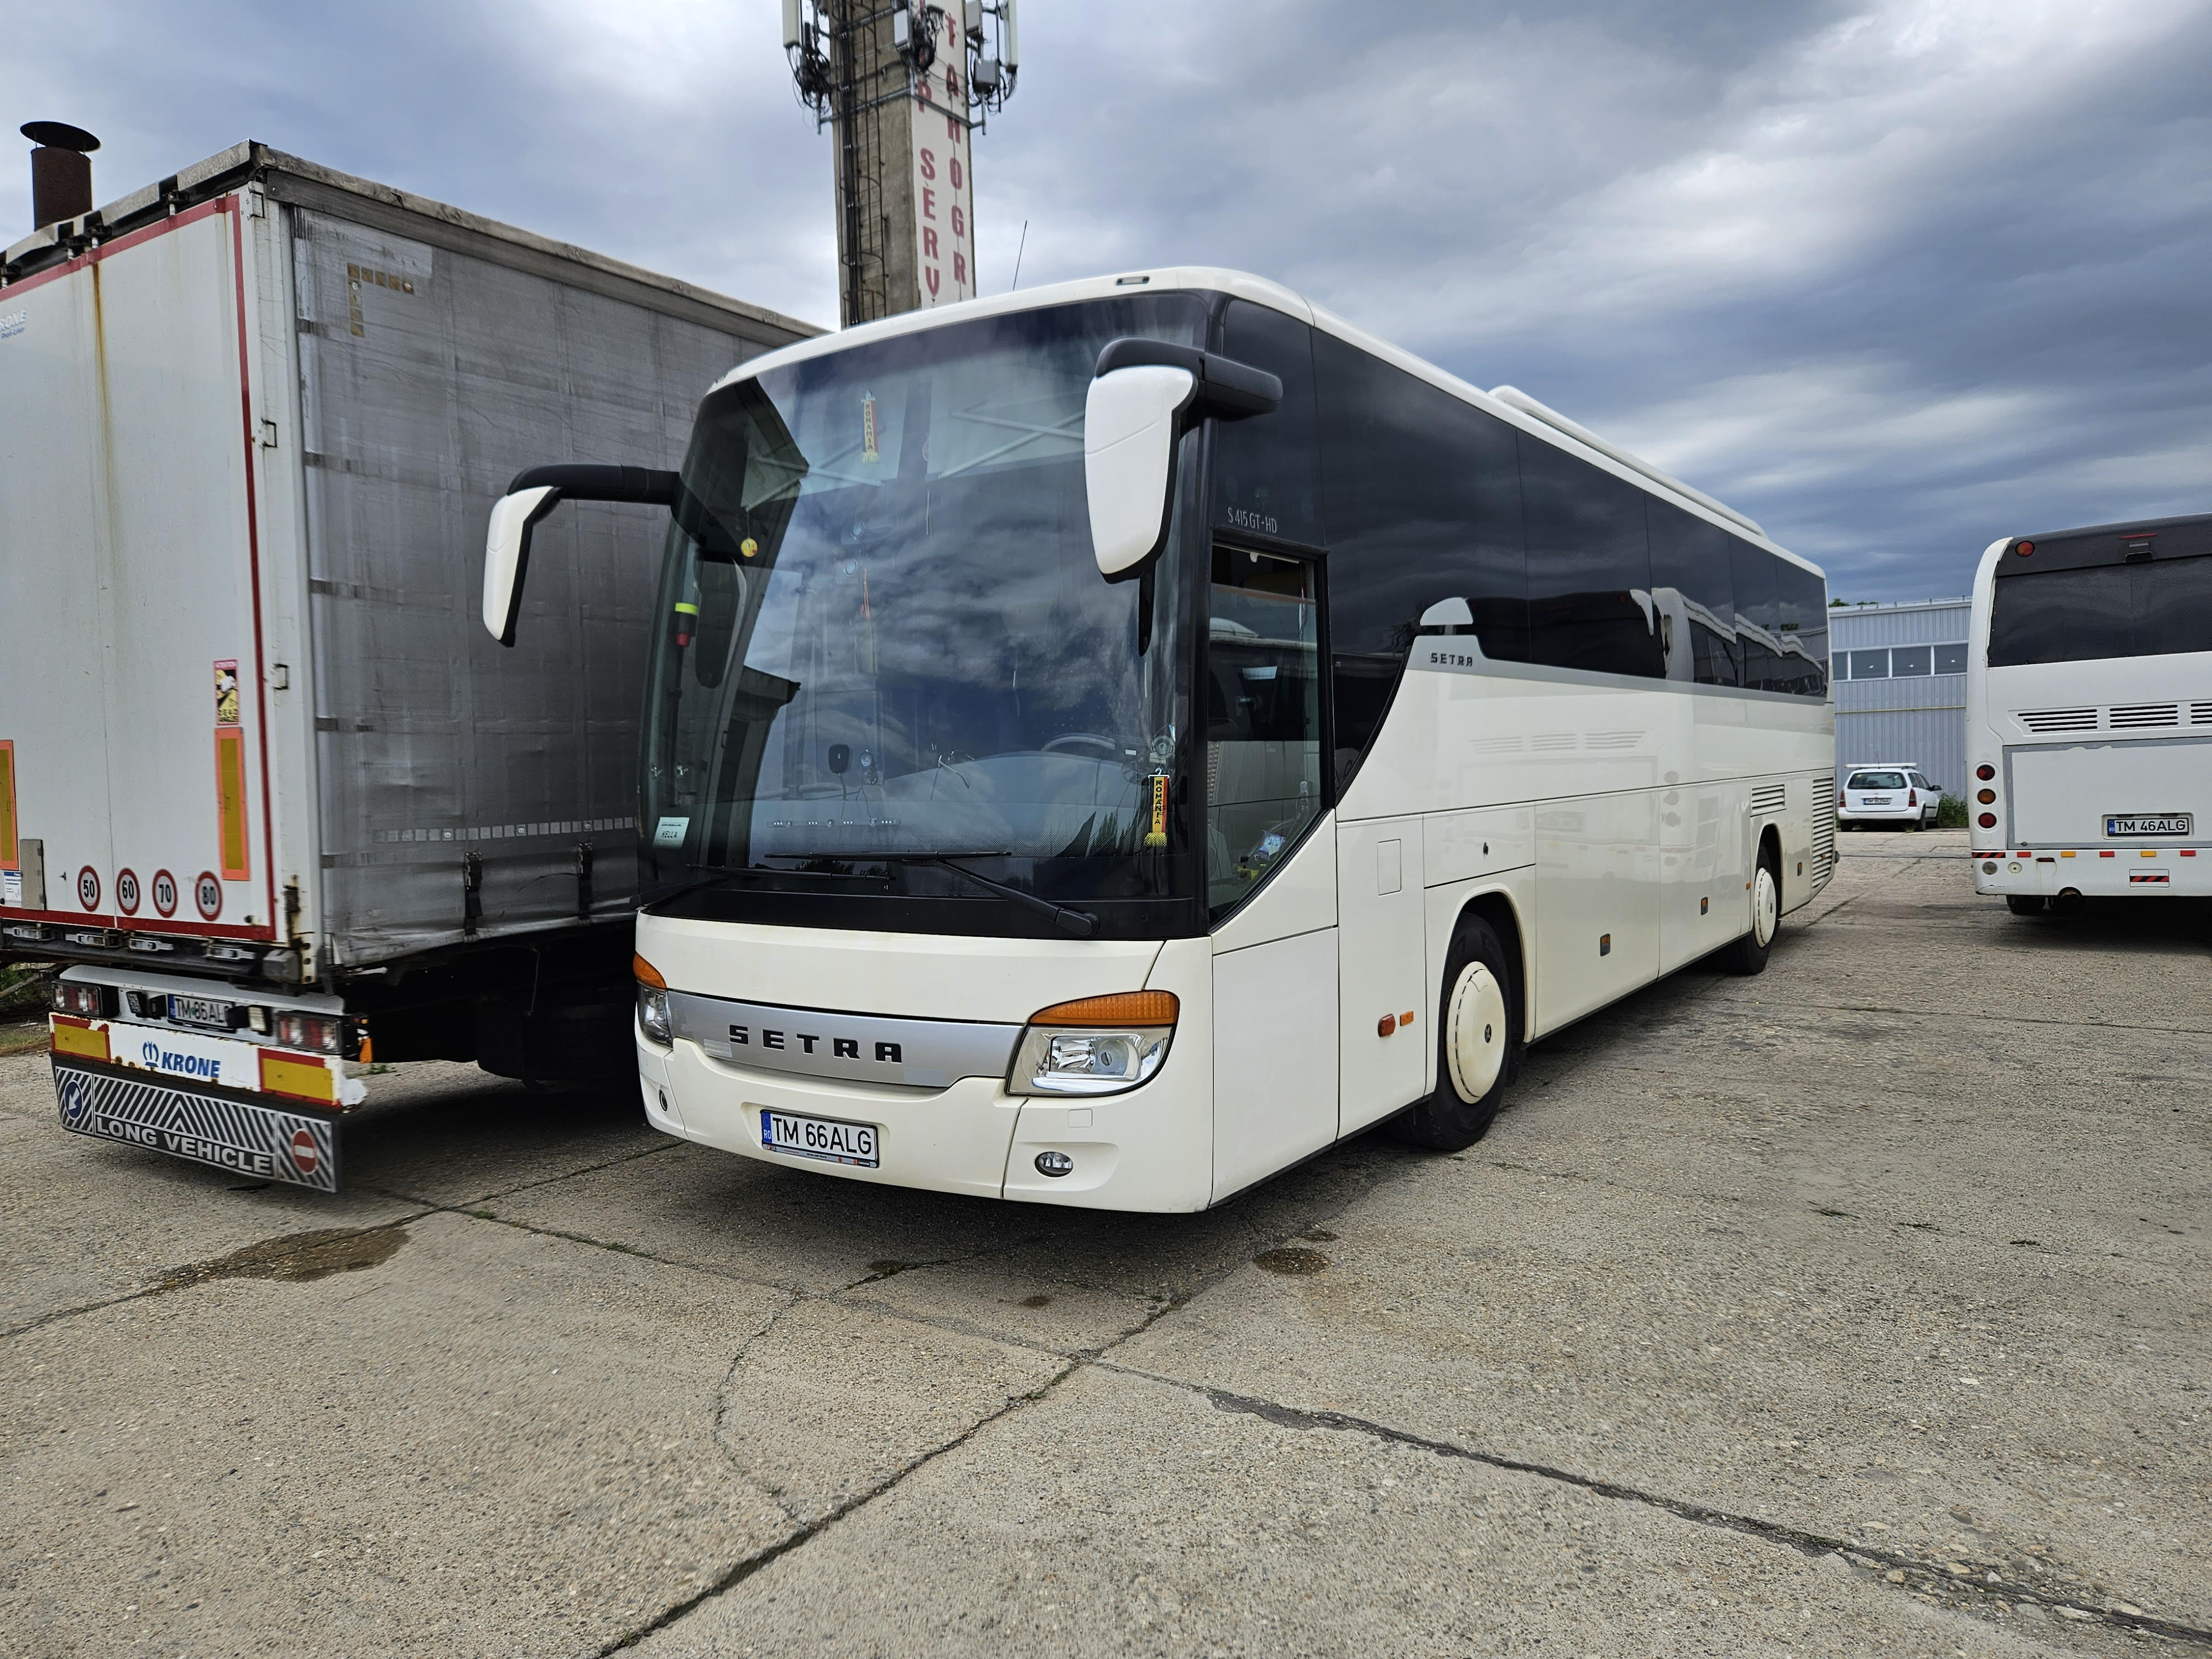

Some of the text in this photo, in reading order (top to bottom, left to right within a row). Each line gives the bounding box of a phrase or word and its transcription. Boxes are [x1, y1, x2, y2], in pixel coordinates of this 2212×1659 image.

[920, 148, 940, 298] SERV
[865, 403, 874, 450] ROMANIA
[1228, 507, 1277, 533] S 415 GT-HD
[1430, 652, 1473, 667] SETRA
[2116, 821, 2135, 832] TM
[2140, 820, 2185, 831] 46ALG
[83, 879, 95, 898] 50
[122, 880, 134, 899] 60
[158, 884, 171, 902] 70
[202, 885, 216, 905] 80
[175, 998, 191, 1018] TM
[729, 1025, 902, 1063] SETRA
[161, 1052, 221, 1078] KRONE
[96, 1117, 273, 1174] LONG VEHICLE
[764, 1118, 872, 1155] RO TM 66ALG
